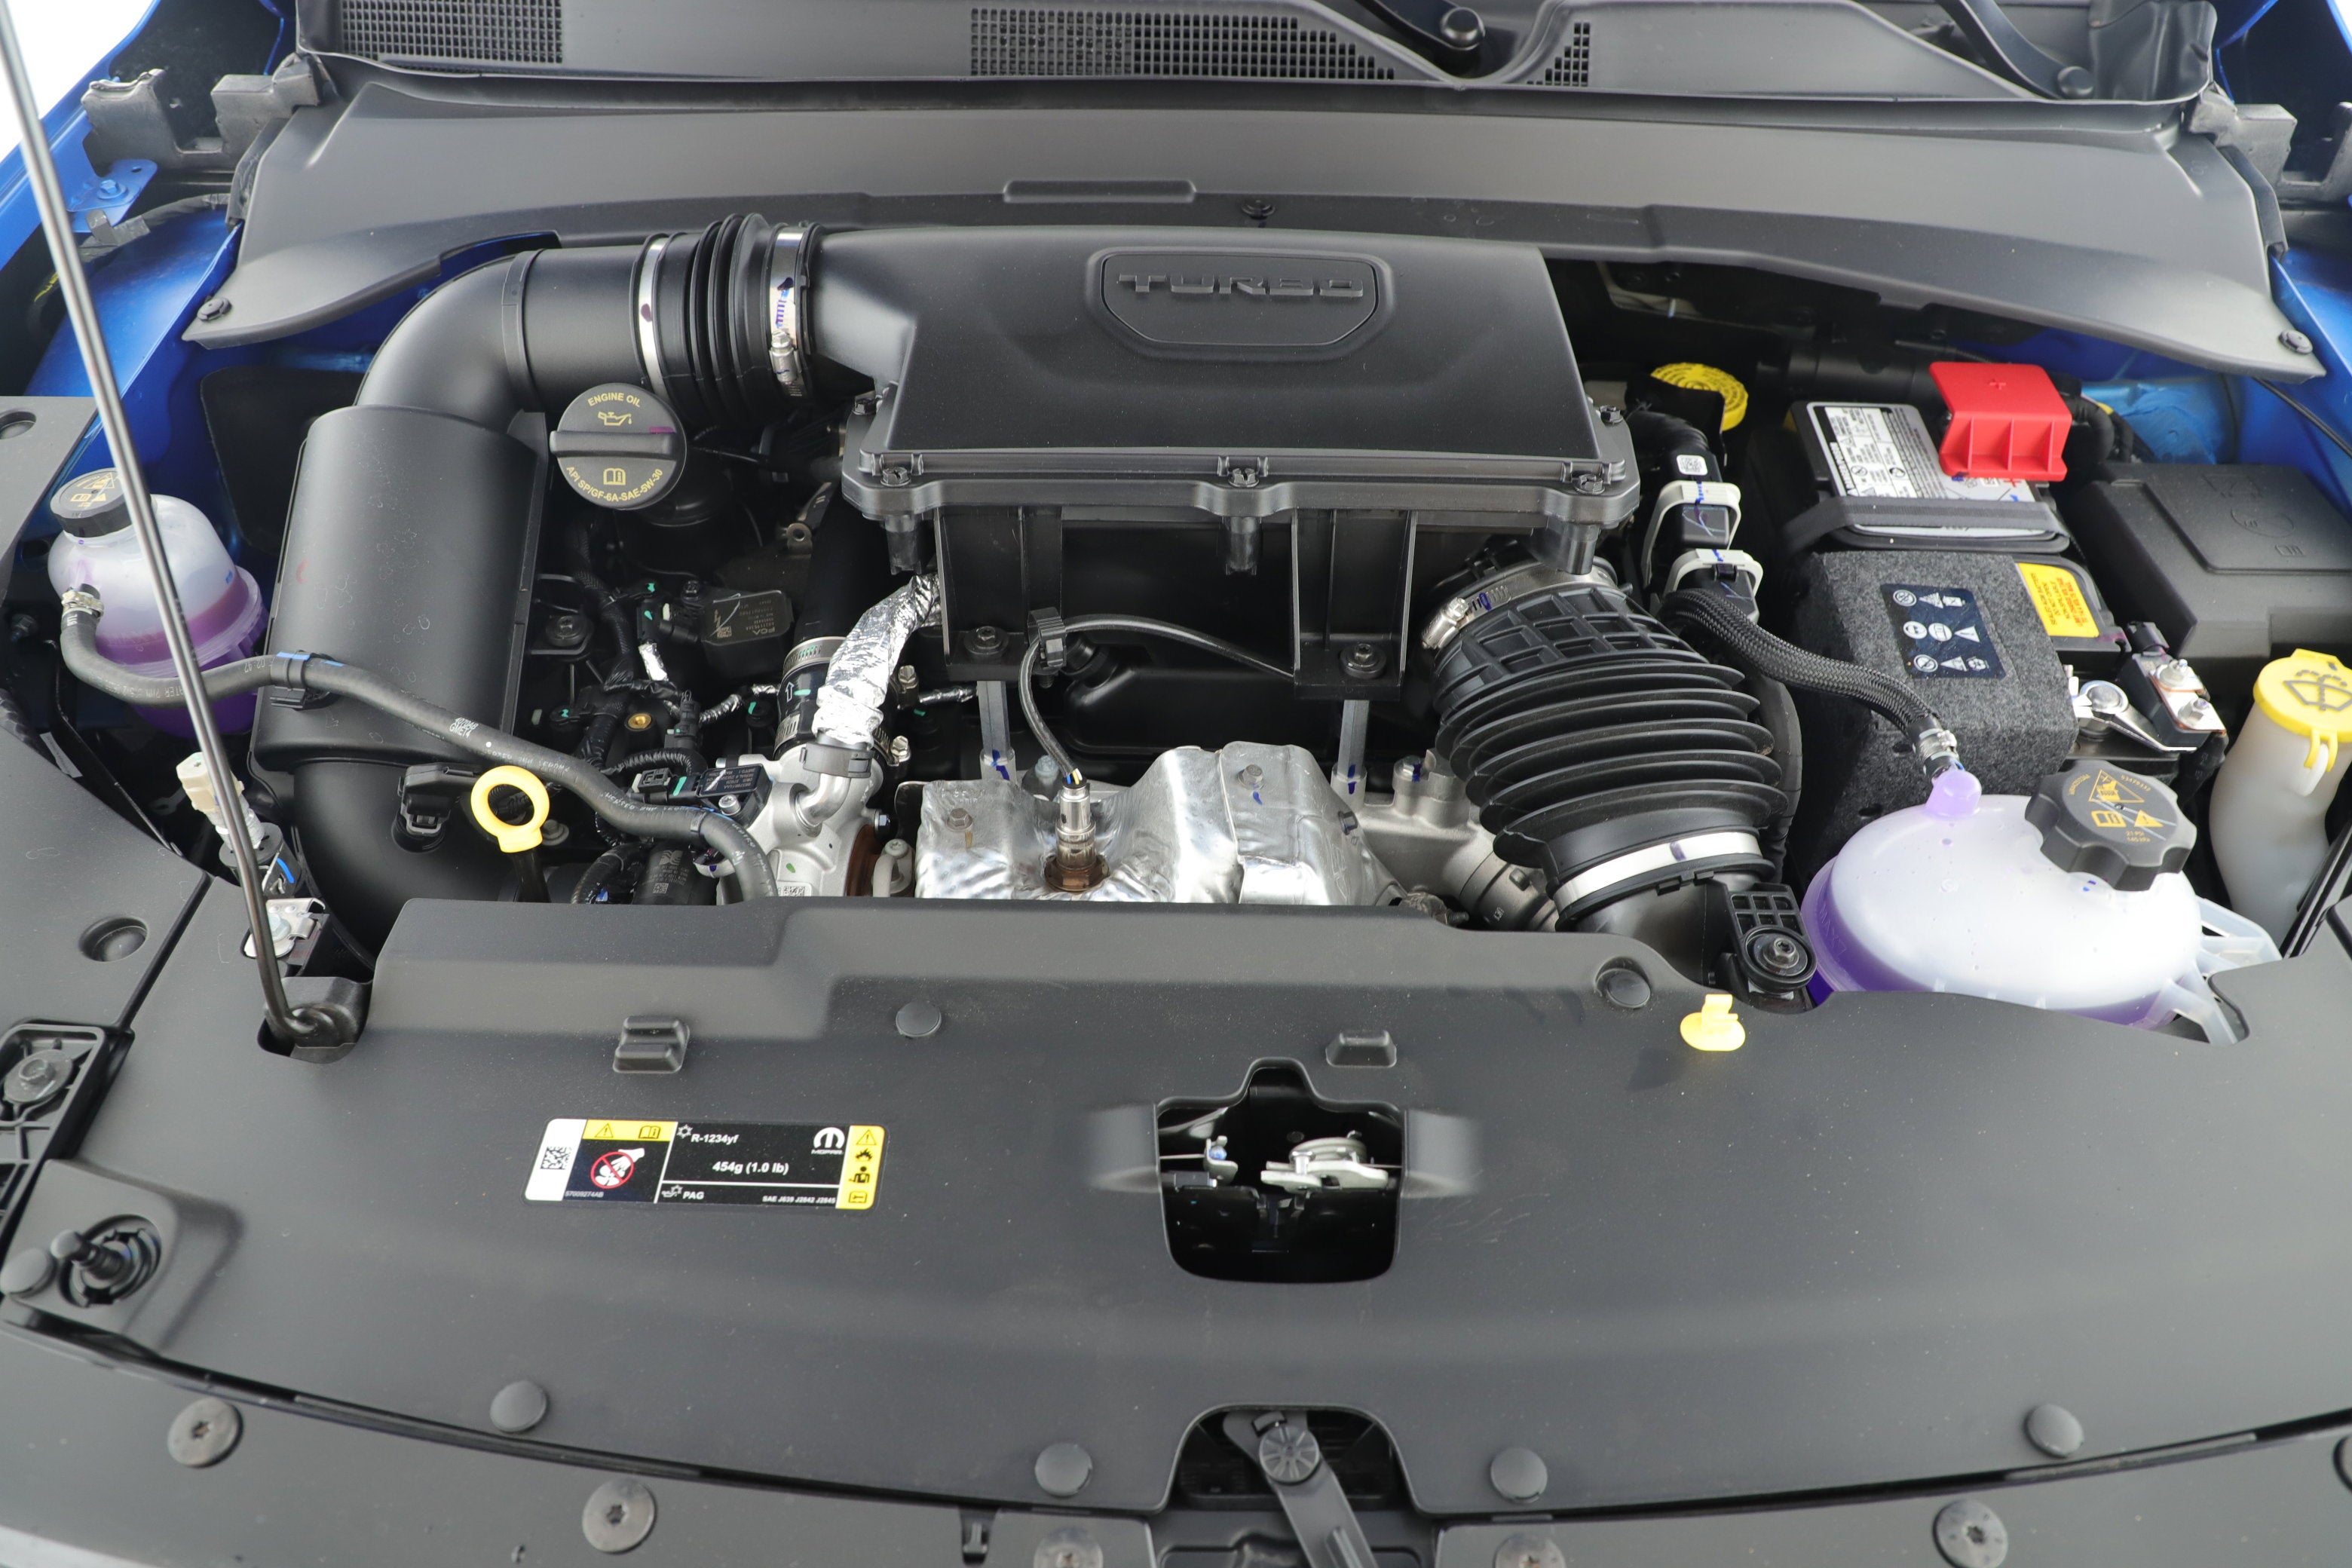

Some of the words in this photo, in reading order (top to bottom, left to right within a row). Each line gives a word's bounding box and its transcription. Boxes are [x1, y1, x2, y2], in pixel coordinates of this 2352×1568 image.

[1119, 274, 1363, 298] TURBO
[587, 392, 624, 407] ENGINE
[626, 394, 642, 407] OIL
[566, 466, 580, 482] API
[691, 1133, 740, 1145] R-1234yf
[712, 1161, 743, 1174] 454g
[746, 1162, 770, 1174] (1.0
[771, 1162, 789, 1175] lb)
[682, 1191, 705, 1200] PAG
